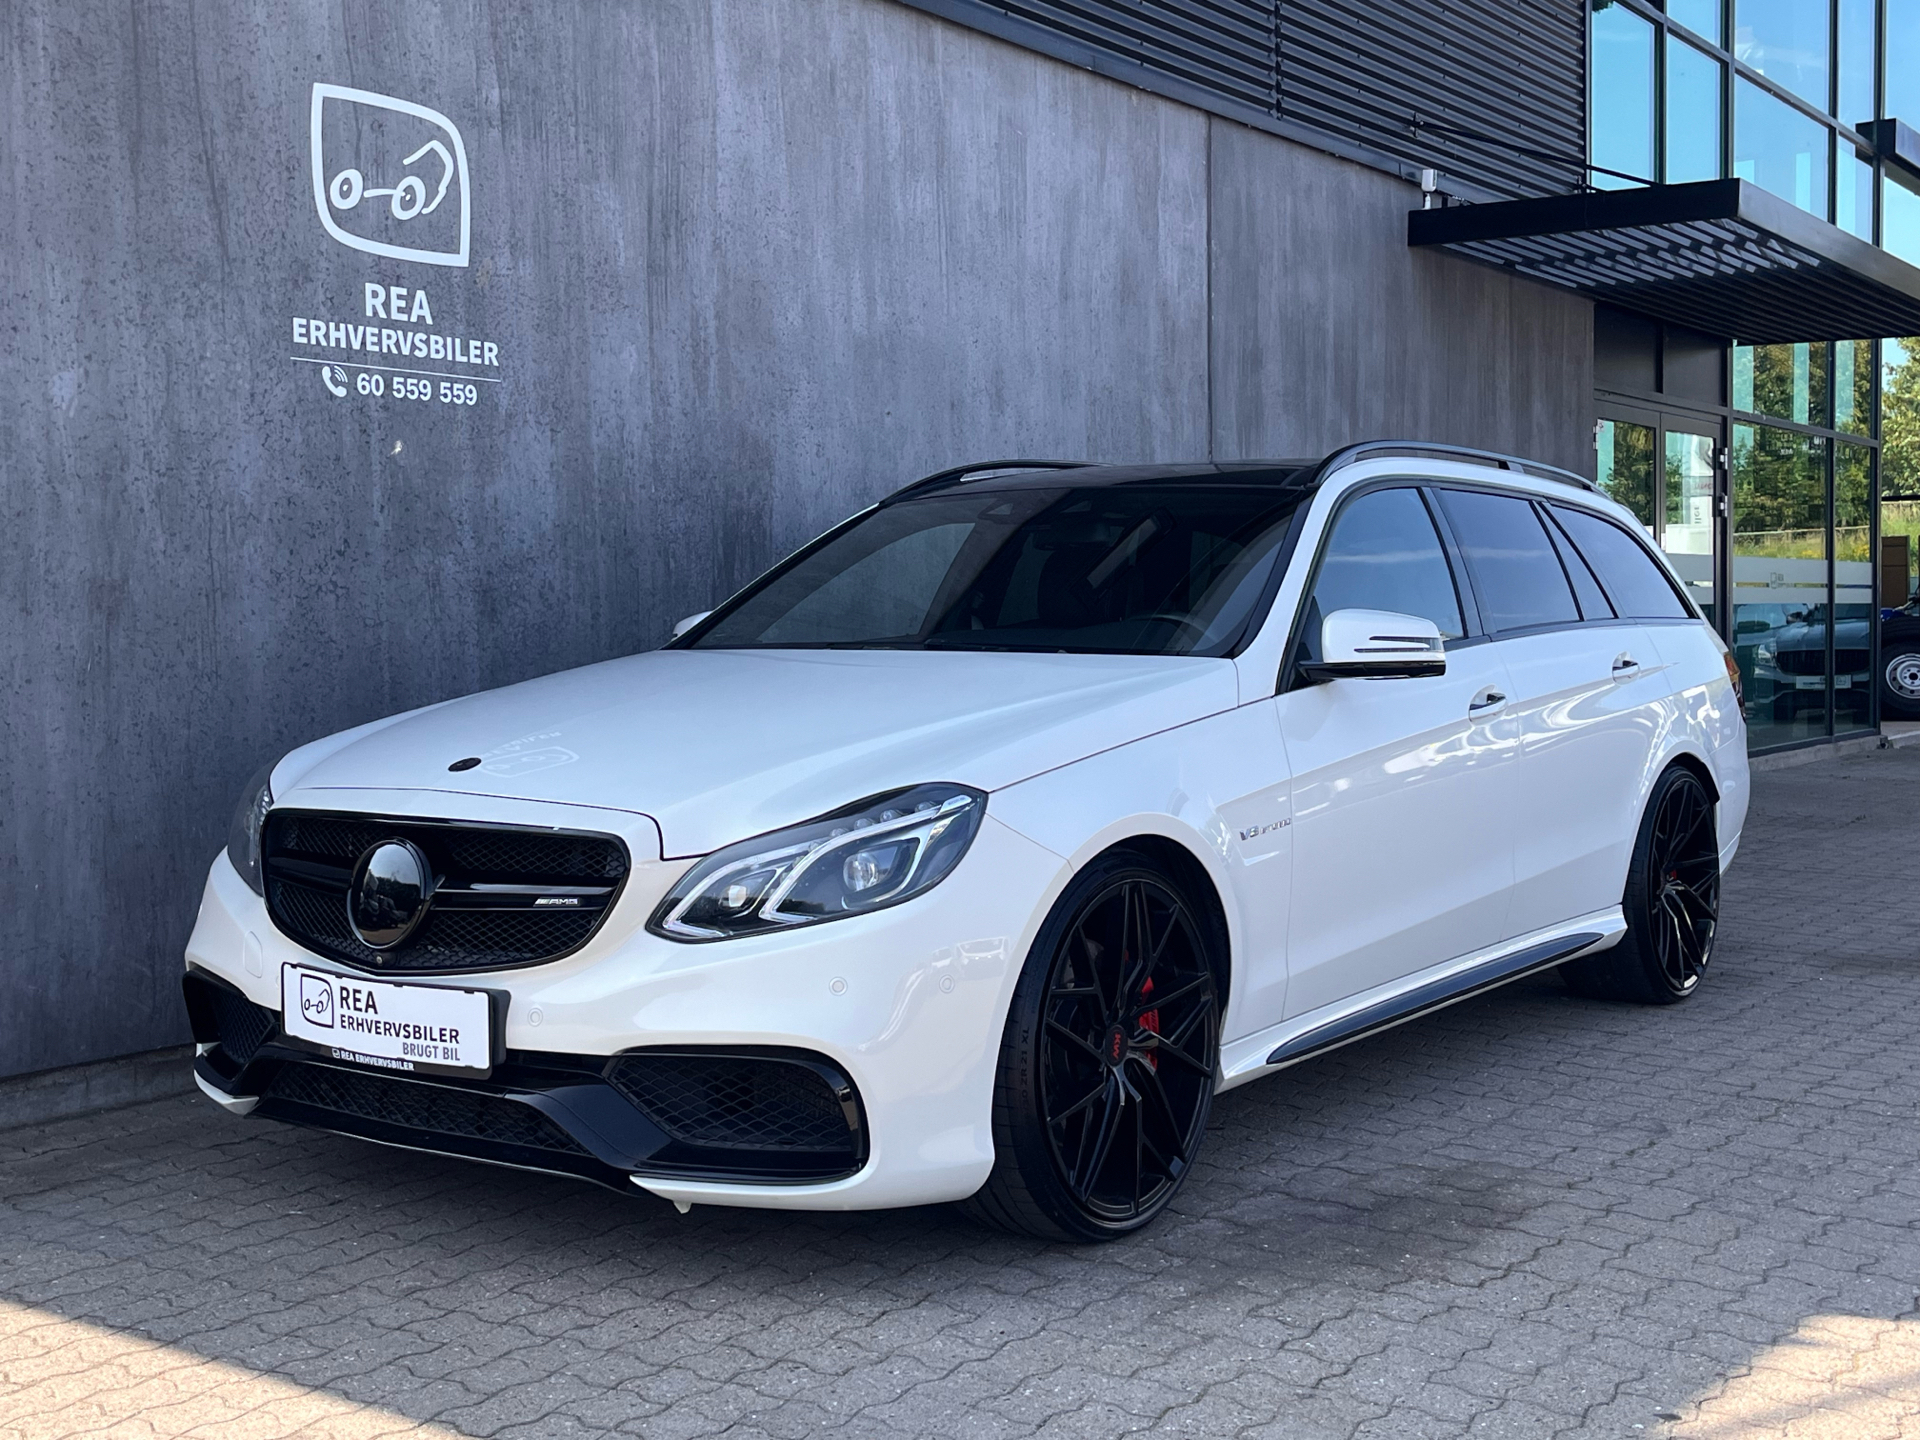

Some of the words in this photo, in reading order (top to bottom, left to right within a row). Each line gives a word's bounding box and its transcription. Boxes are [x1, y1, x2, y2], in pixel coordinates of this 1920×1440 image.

[365, 282, 433, 325] REA
[292, 317, 499, 367] ERHVERVSBILER
[356, 373, 385, 397] 60
[392, 376, 432, 401] 559
[439, 381, 478, 406] 559
[339, 985, 378, 1015] REA
[340, 1014, 460, 1045] ERHVERVSBILER
[1021, 1027, 1030, 1045] XL
[340, 1050, 355, 1061] REA
[355, 1053, 415, 1071] ERHVERVSBILER
[402, 1042, 439, 1060] BRUGT
[442, 1047, 461, 1061] BIL
